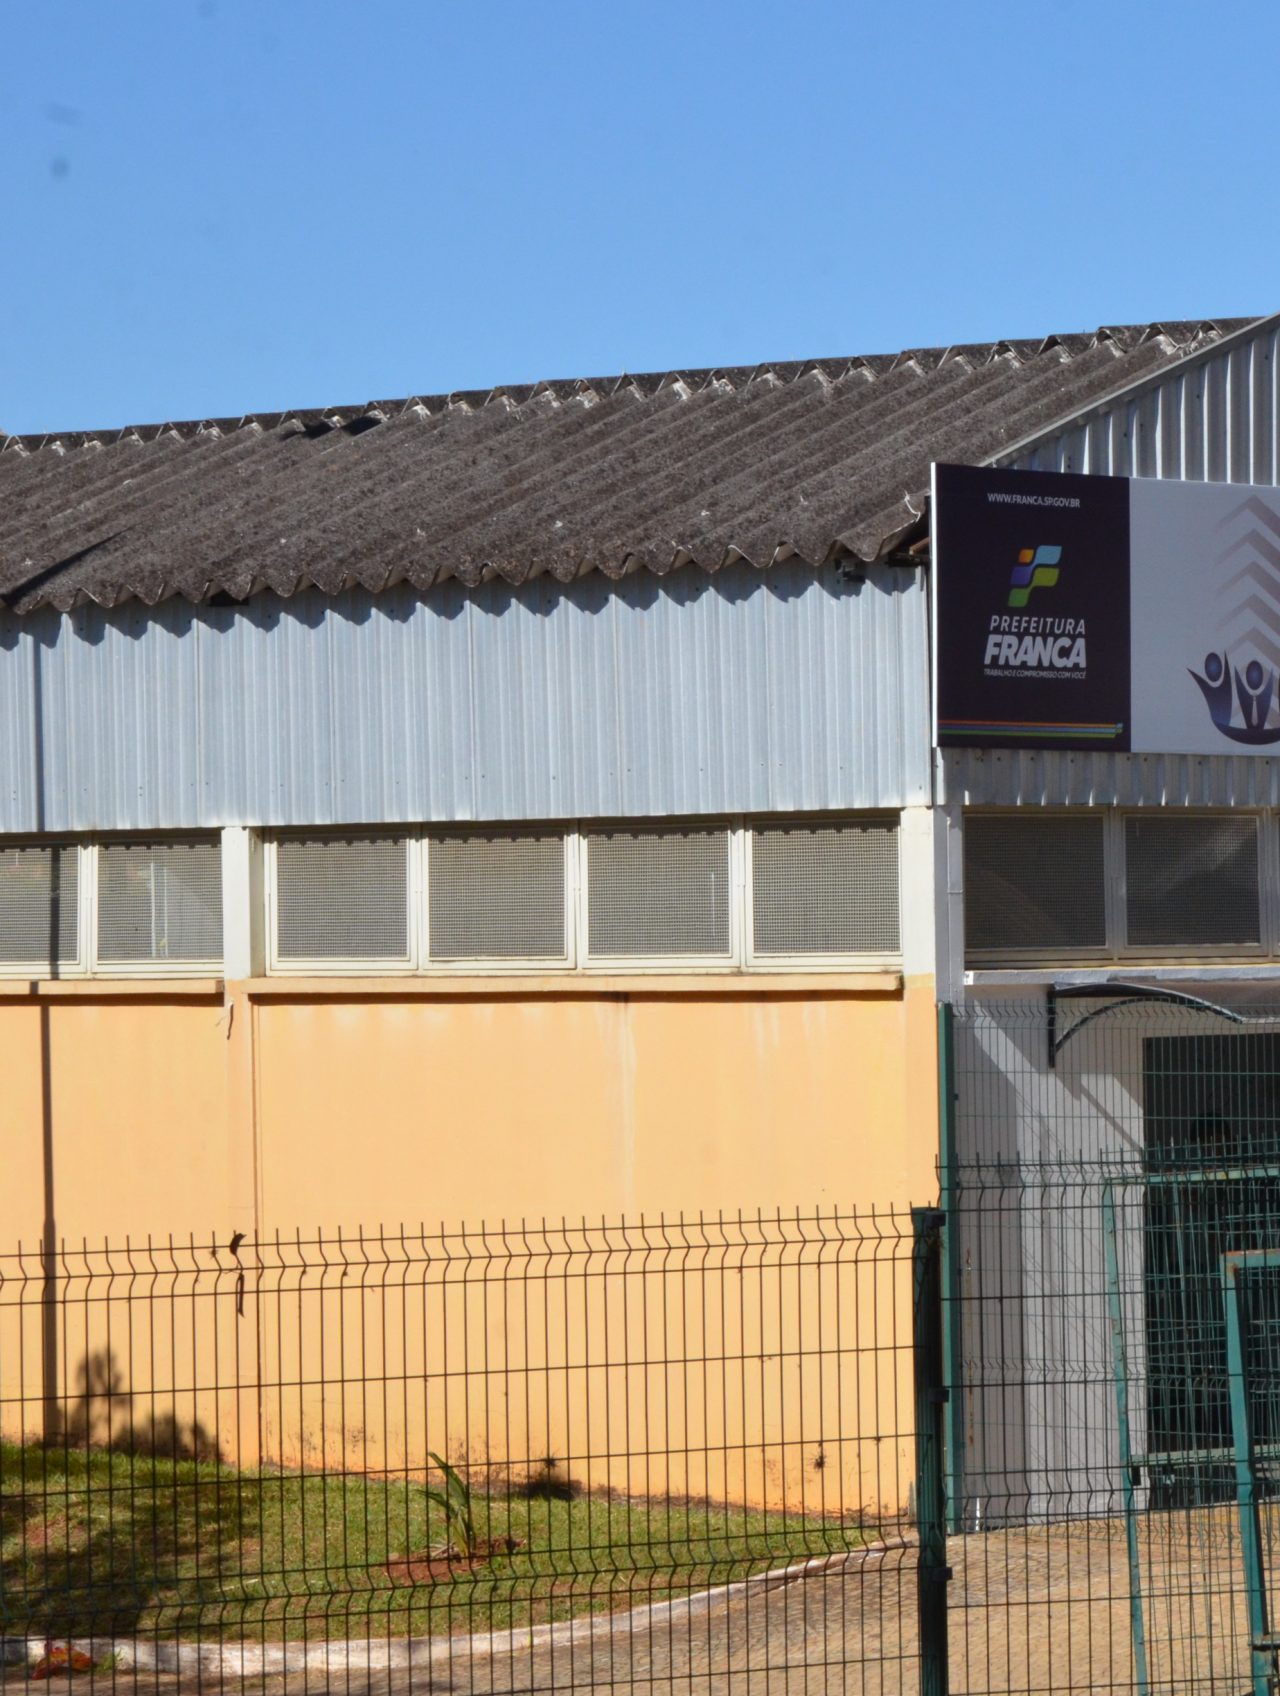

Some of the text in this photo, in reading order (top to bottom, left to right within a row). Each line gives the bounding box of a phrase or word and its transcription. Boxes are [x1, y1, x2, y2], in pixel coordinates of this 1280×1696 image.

[990, 615, 1086, 635] PREFEITURA
[984, 634, 1086, 668] FRANCA
[984, 669, 1011, 677] TRABALHO
